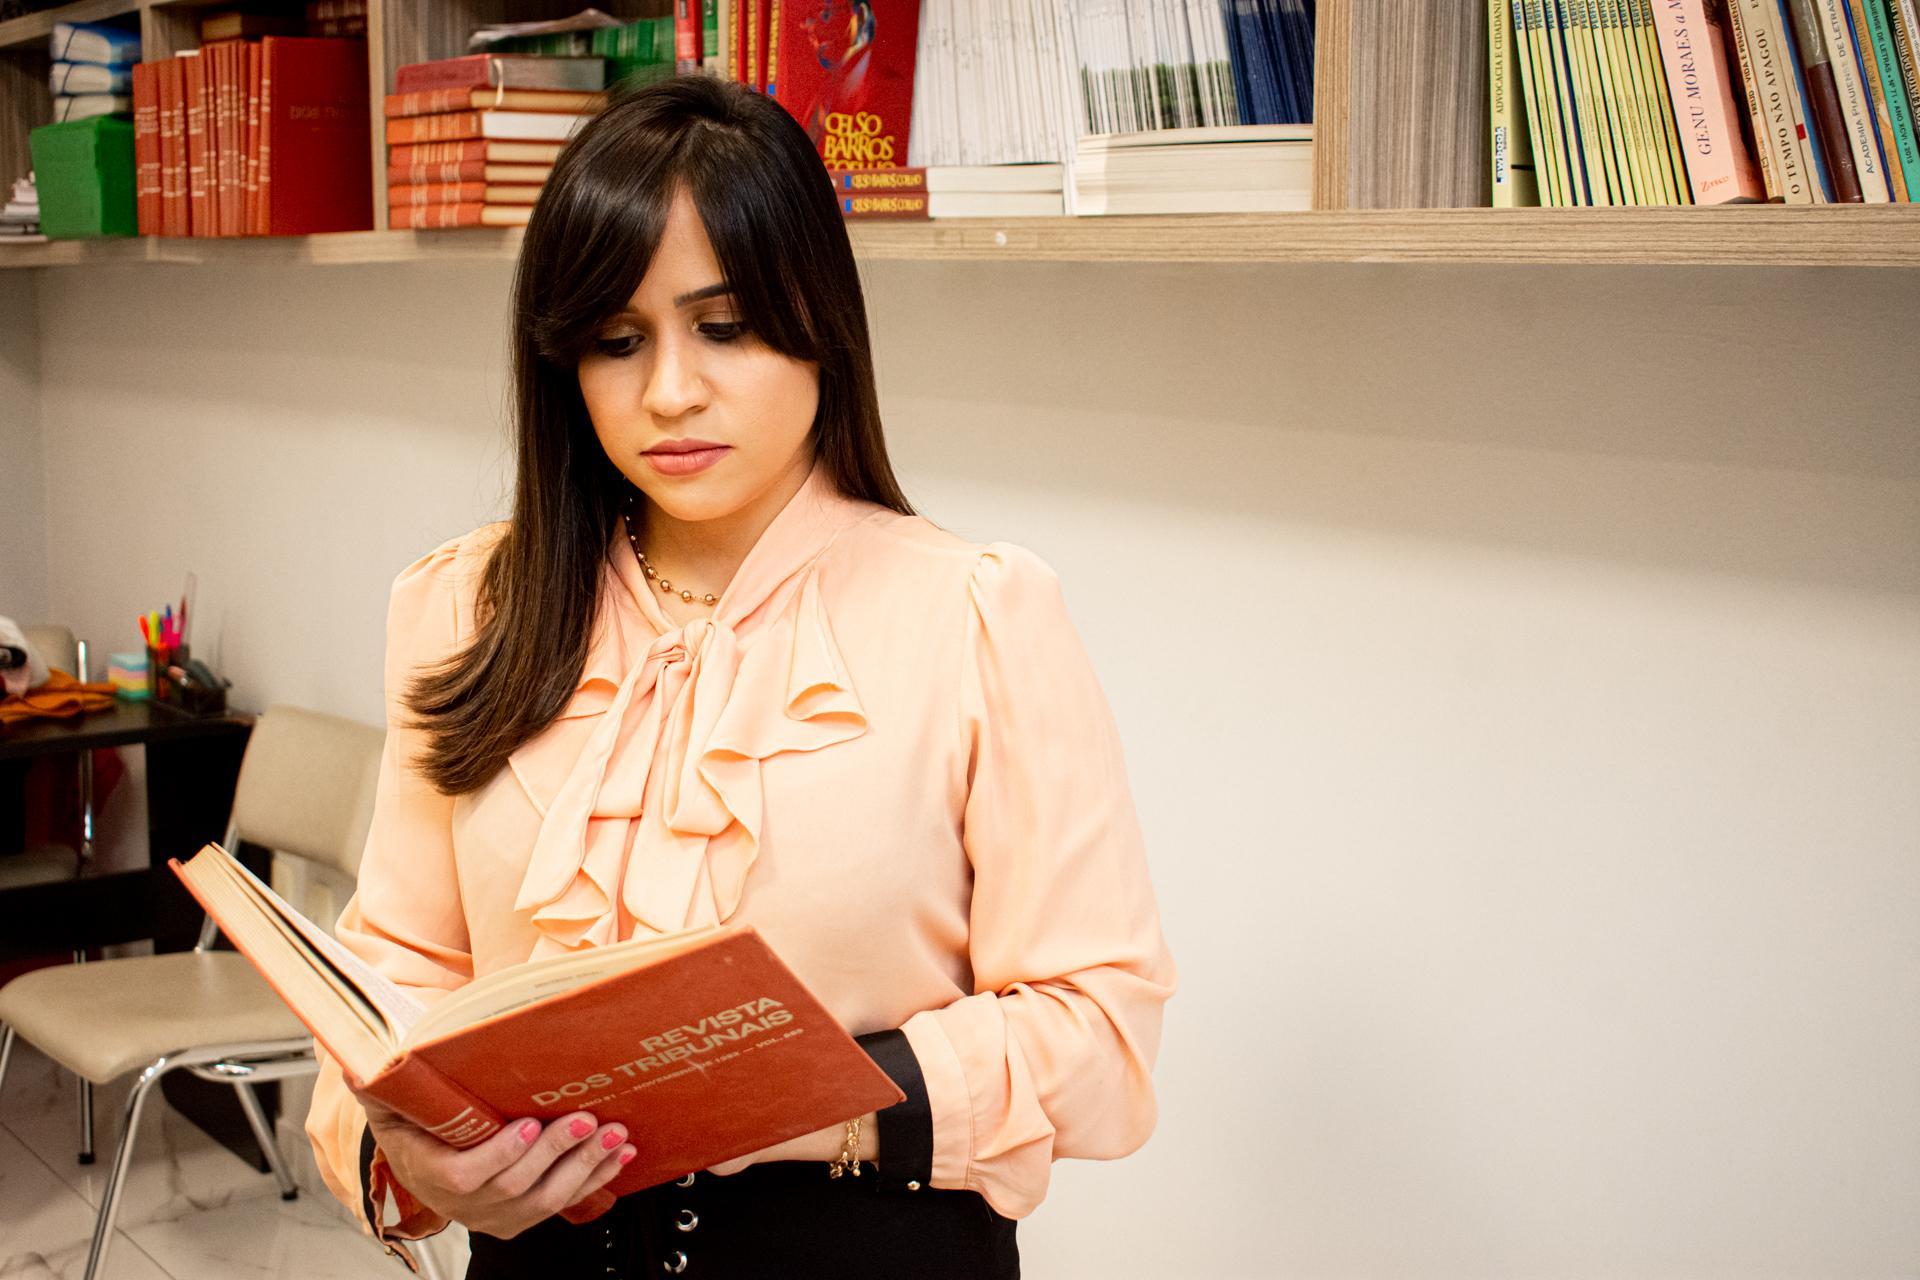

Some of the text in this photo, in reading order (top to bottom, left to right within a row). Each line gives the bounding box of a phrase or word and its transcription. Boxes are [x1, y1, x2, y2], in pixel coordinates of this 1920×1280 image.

[1494, 0, 1502, 49] CIDADANI
[1513, 2, 1522, 30] PERFIS
[1525, 1, 1535, 30] PERFIS
[1533, 0, 1543, 28] PERFIS
[1545, 1, 1555, 29] PERFIS
[1559, 1, 1569, 29] PERFIS
[1579, 1, 1588, 29] PERFIS
[1589, 1, 1599, 29] PERFIS
[1599, 1, 1609, 28] PERFIS
[1609, 0, 1618, 28] PERFIS
[1674, 28, 1701, 99] MORAES
[1743, 61, 1752, 81] VIDA
[1494, 59, 1504, 114] ADVOCACIA
[1880, 43, 1892, 73] LETRAS
[1895, 105, 1904, 121] ANO
[1748, 89, 1758, 116] FREUD
[1755, 28, 1800, 195] O TEMPO NÃO APAGOU
[825, 111, 882, 136] CELSO
[1690, 105, 1712, 155] GENU
[823, 135, 895, 161] BARROS
[1856, 119, 1875, 174] ACADEMIA
[639, 997, 784, 1052] REVISTA
[531, 1009, 794, 1106] DOS TRIBUNAIS
